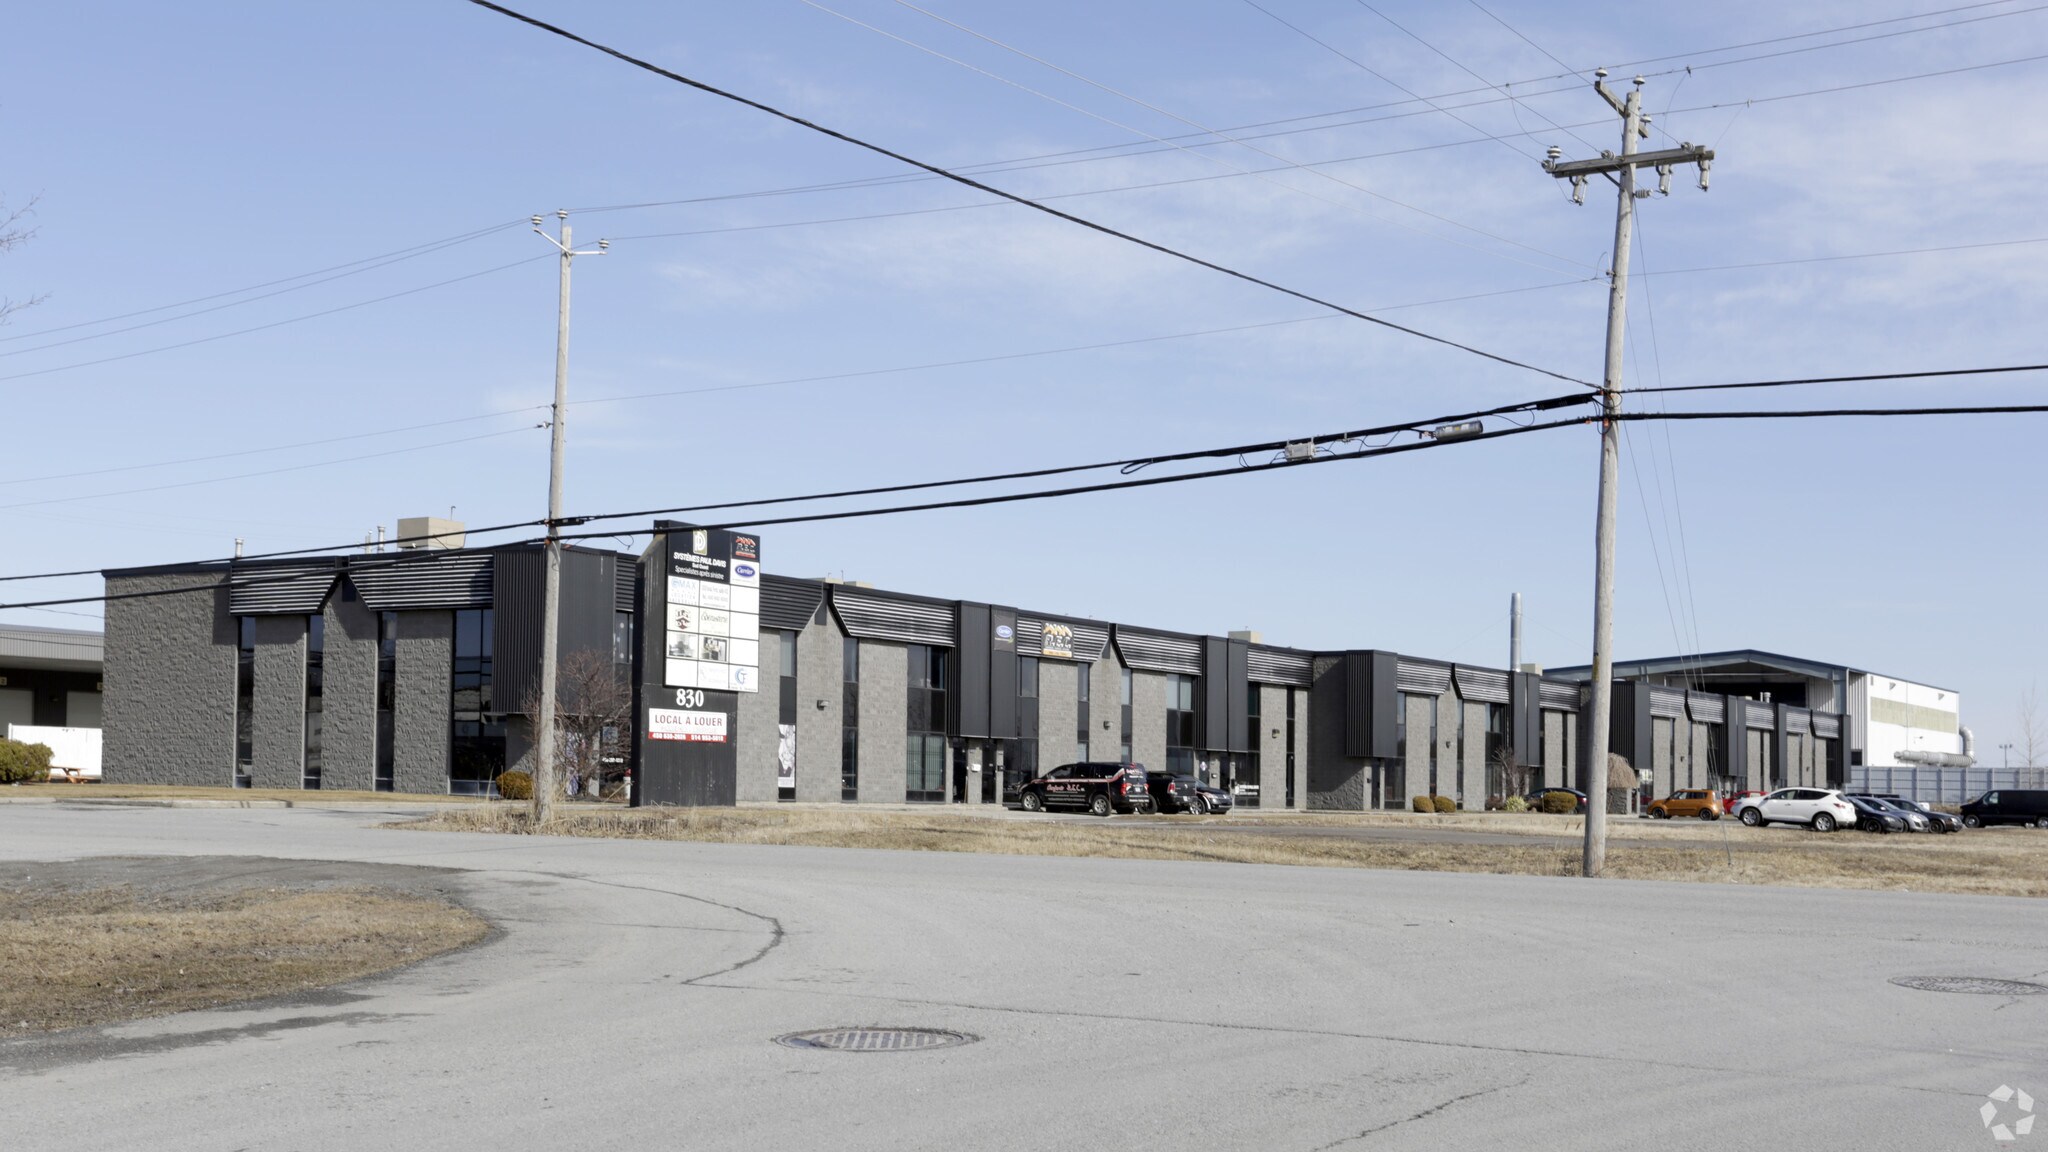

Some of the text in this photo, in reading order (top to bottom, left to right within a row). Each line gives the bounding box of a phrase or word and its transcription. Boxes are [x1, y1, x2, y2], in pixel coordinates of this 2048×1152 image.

[676, 688, 704, 708] 830
[655, 714, 723, 726] LOCAL A LOUER
